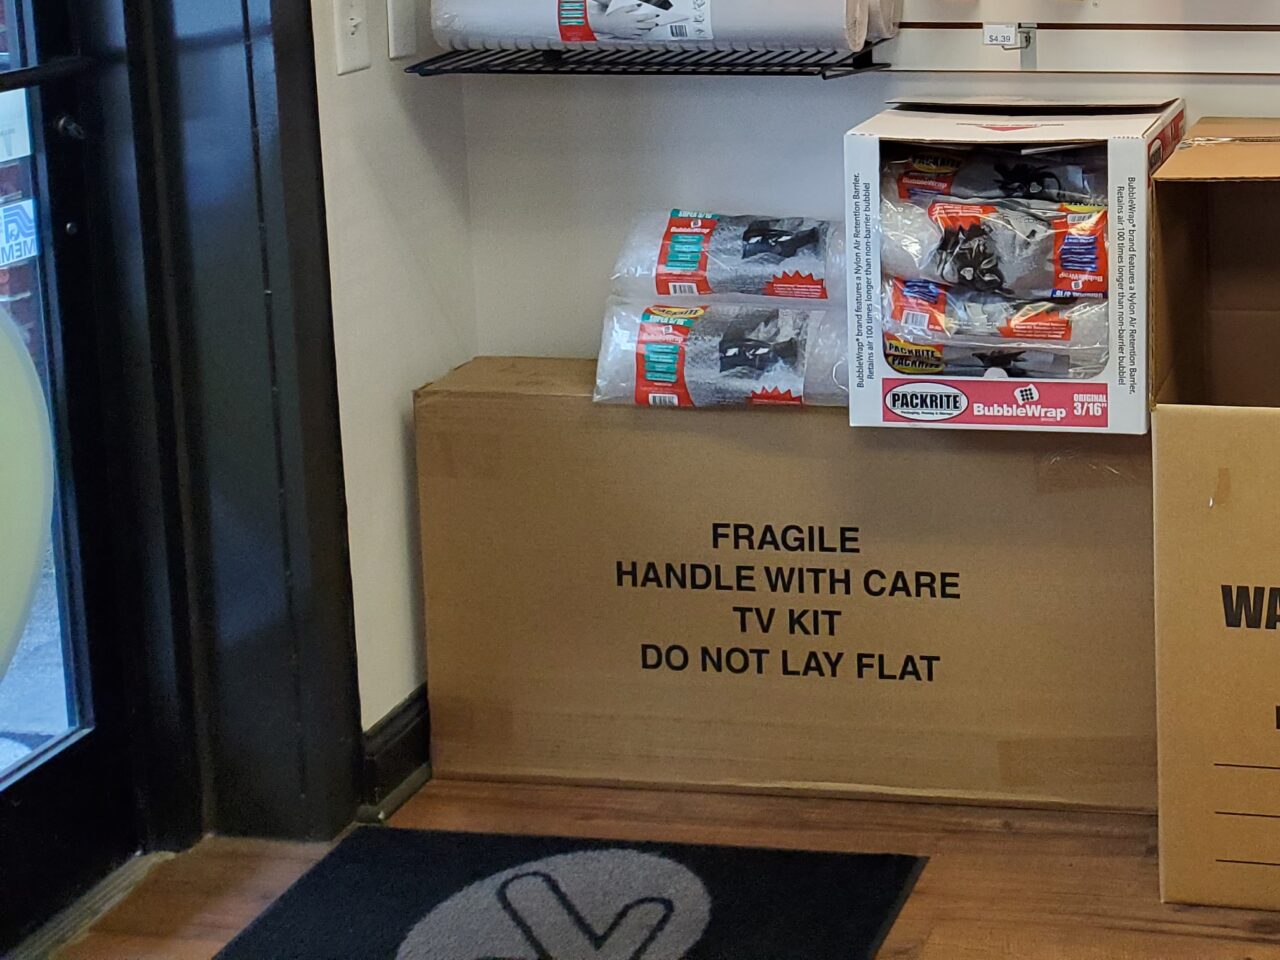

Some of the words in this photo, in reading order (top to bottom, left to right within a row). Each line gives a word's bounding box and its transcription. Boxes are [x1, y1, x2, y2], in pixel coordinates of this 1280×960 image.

[989, 34, 1011, 44] $4.39
[854, 252, 863, 275] Nylon
[854, 282, 862, 313] features
[855, 314, 863, 337] brand
[891, 392, 960, 410] PACKRITE
[1073, 393, 1107, 403] ORIGINAL
[1073, 402, 1108, 417] 3/16"
[973, 403, 1066, 420] BubbleWrap
[711, 522, 860, 553] FRAGILE
[615, 560, 756, 591] HANDLE
[764, 566, 851, 595] WITH
[863, 569, 961, 599] CARE
[733, 606, 775, 634] TV
[788, 608, 842, 636] KIT
[641, 643, 689, 671] DO
[701, 646, 770, 674] NOT
[781, 649, 844, 678] LAY
[856, 652, 940, 682] FLAT
